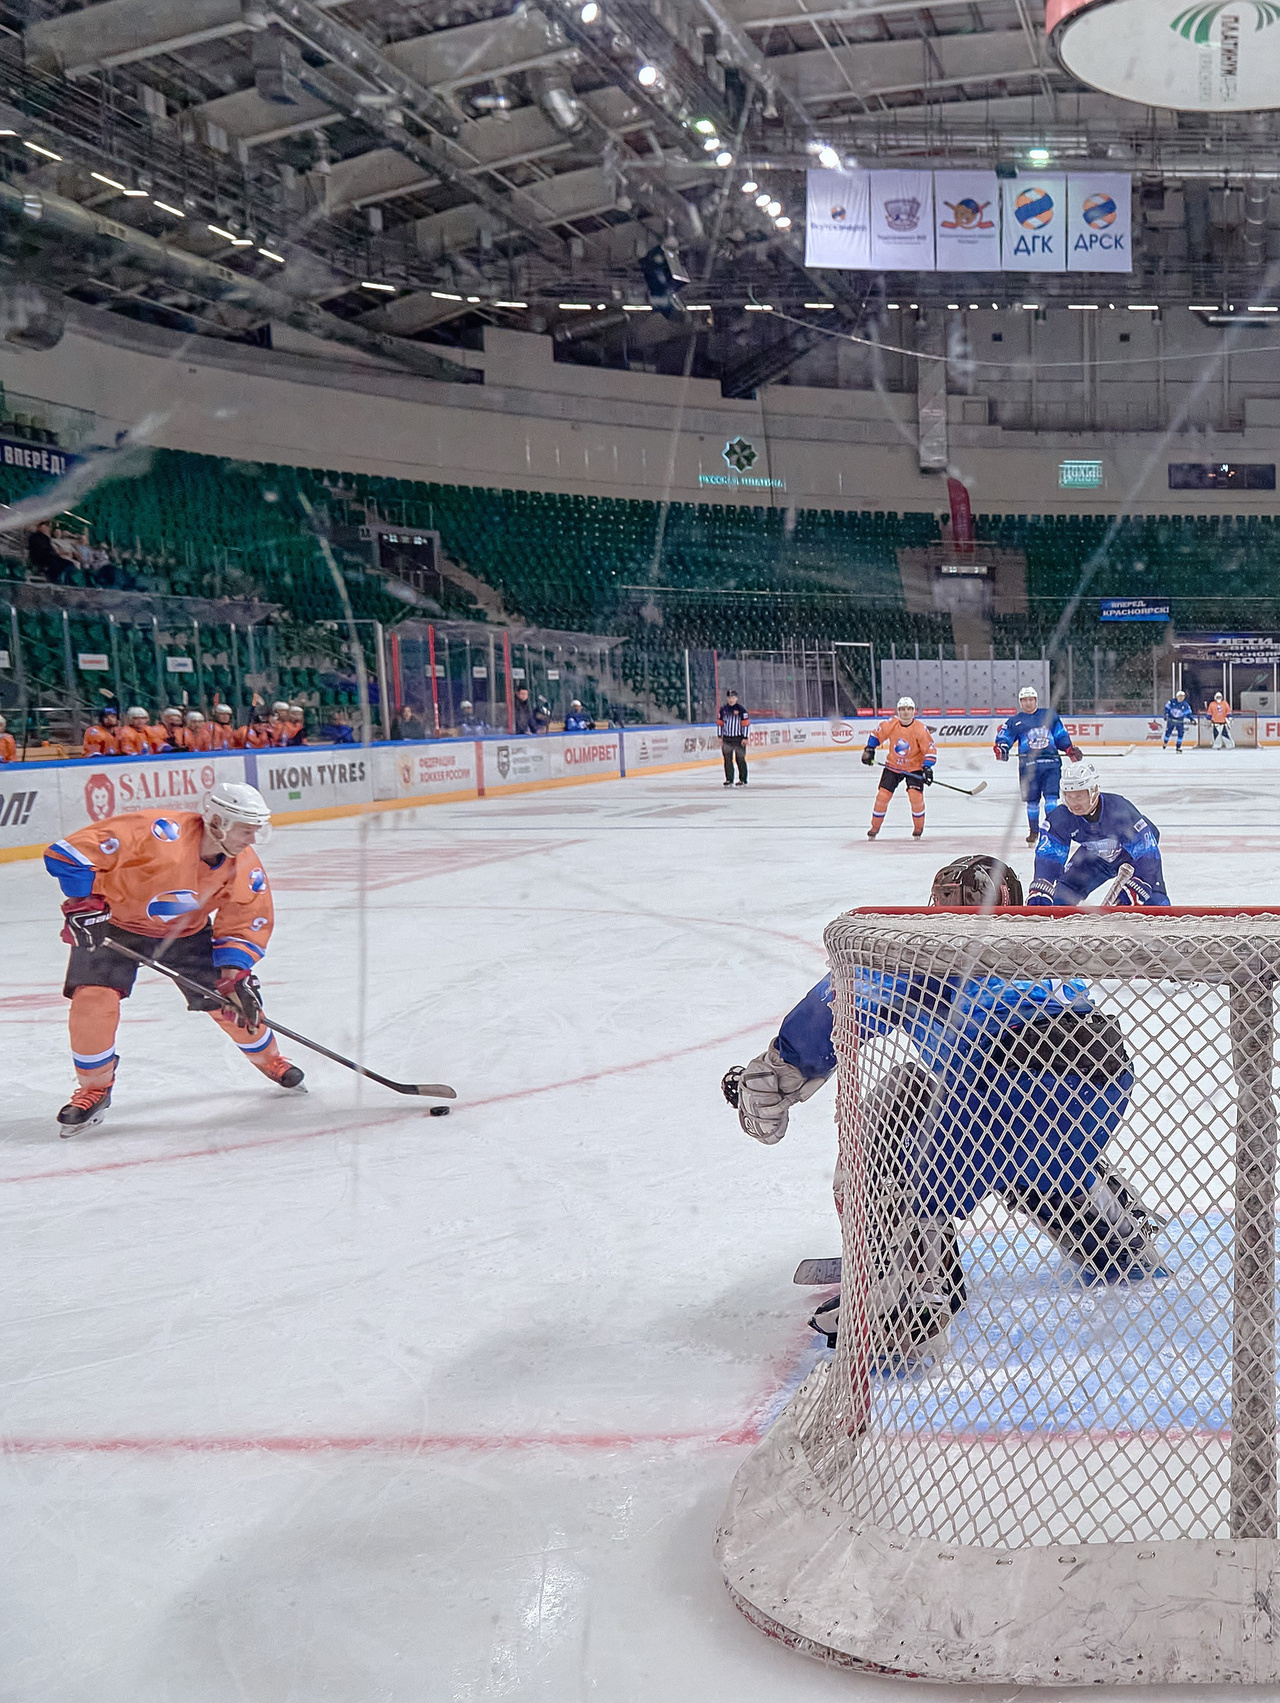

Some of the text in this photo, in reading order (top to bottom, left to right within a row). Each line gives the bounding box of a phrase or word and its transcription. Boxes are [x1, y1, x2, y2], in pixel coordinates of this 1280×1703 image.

[1014, 235, 1053, 256] ДГК
[939, 724, 989, 736] СОКОЛ!
[564, 744, 618, 764] OLIMPBET
[119, 769, 197, 801] SALEK
[269, 762, 365, 790] IKON TYRES
[0, 791, 38, 826] Л!
